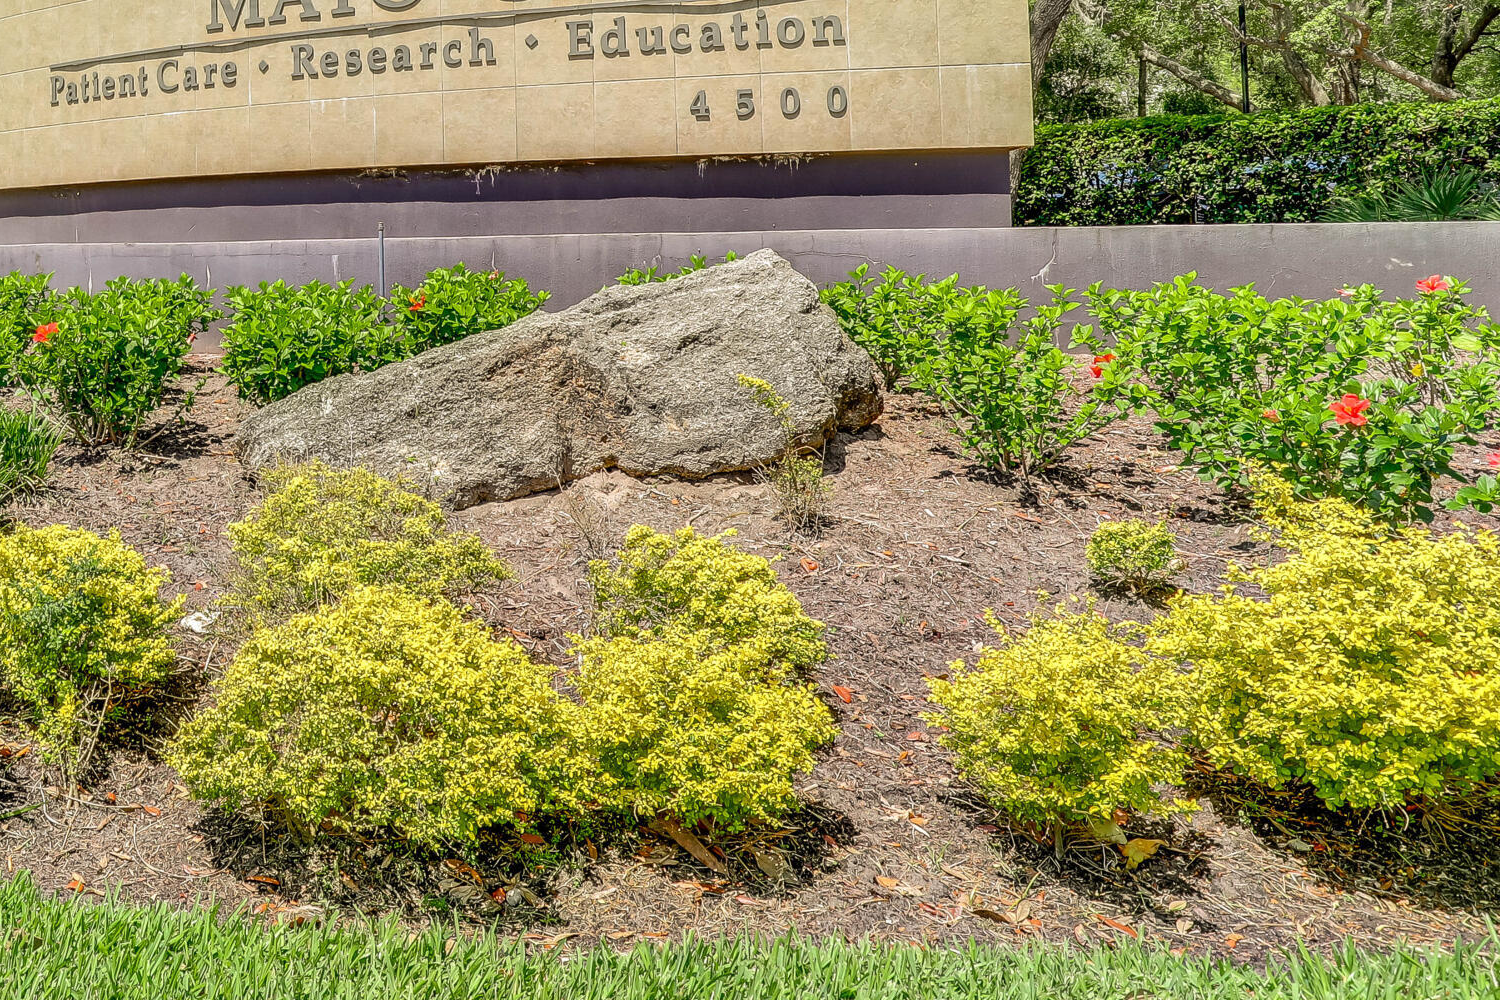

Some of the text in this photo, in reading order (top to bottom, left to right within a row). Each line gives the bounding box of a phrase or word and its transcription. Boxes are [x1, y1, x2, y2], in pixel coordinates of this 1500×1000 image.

[49, 8, 846, 106] Patient Care Research Education
